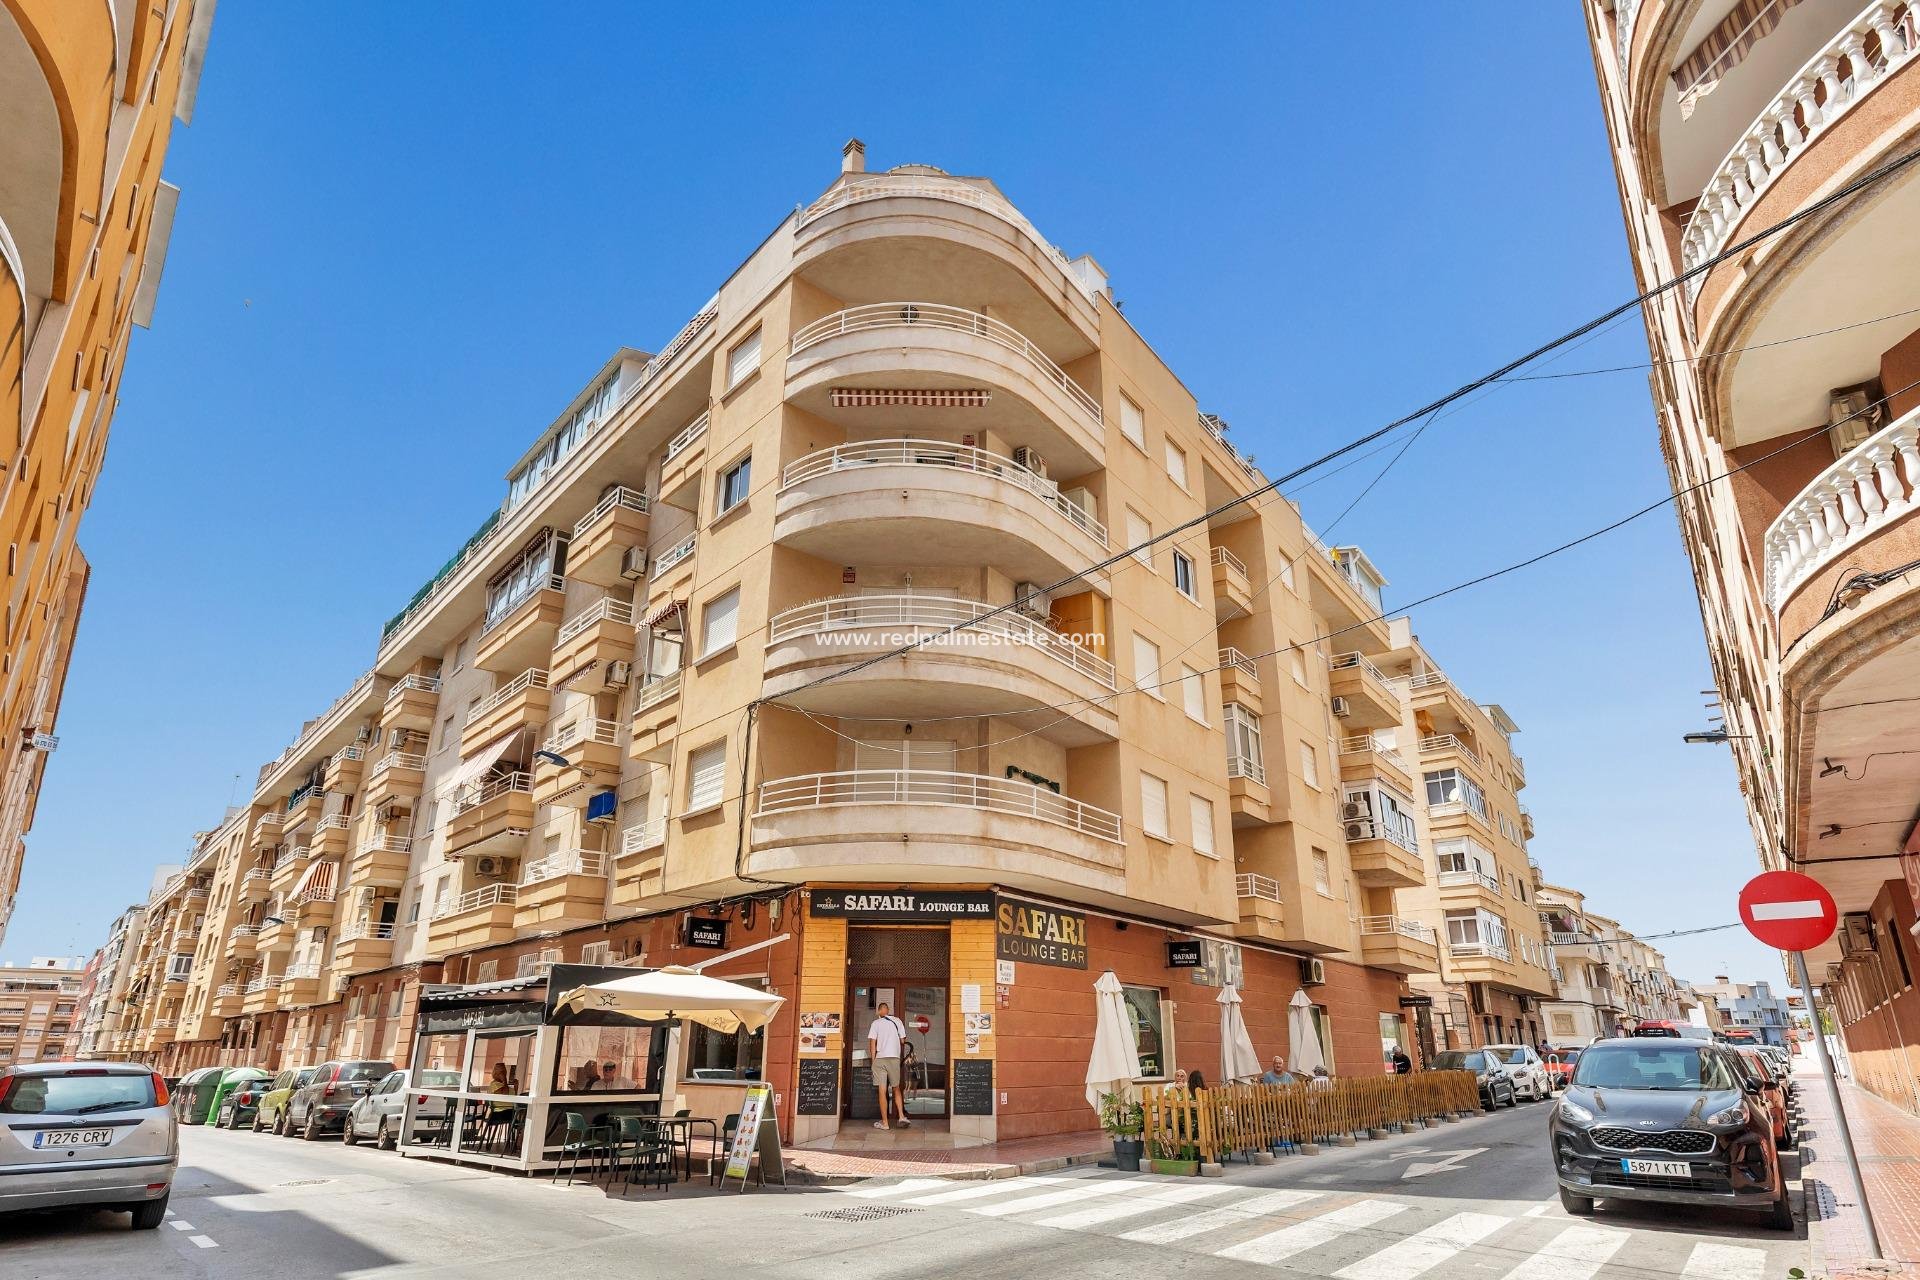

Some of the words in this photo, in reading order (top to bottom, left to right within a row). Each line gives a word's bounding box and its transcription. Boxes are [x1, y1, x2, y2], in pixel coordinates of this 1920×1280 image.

[844, 895, 915, 911] SAFARI
[919, 899, 965, 912] LOUNGE
[967, 899, 990, 913] BAR
[998, 903, 1087, 947] SAFARI
[693, 931, 721, 940] SAFARI
[1002, 938, 1057, 960] LOUNGE
[1061, 946, 1086, 964] BAR
[47, 1132, 79, 1145] 1276
[83, 1131, 109, 1143] CRY
[1630, 1161, 1661, 1174] 5871
[1664, 1162, 1687, 1175] KTT
